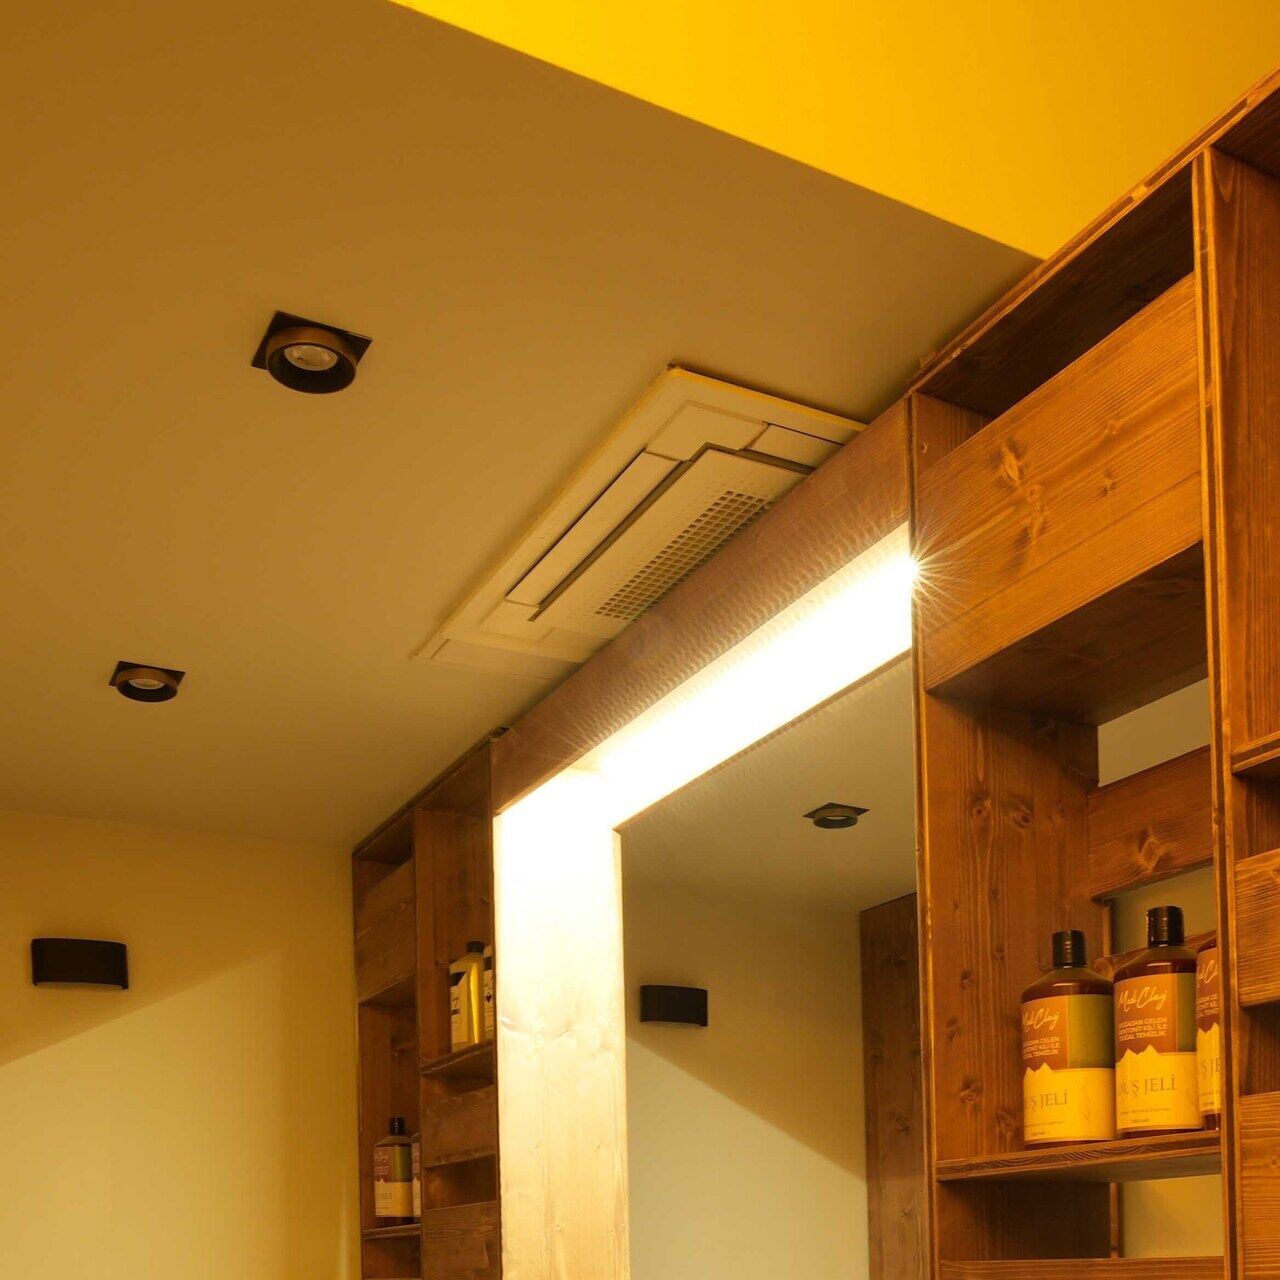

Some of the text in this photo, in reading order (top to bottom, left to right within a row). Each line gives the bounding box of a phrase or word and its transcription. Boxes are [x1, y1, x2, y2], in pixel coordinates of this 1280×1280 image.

[1137, 986, 1168, 1010] Clay
[1144, 1074, 1176, 1095] JELİ
[1039, 1090, 1069, 1110] JELİ
